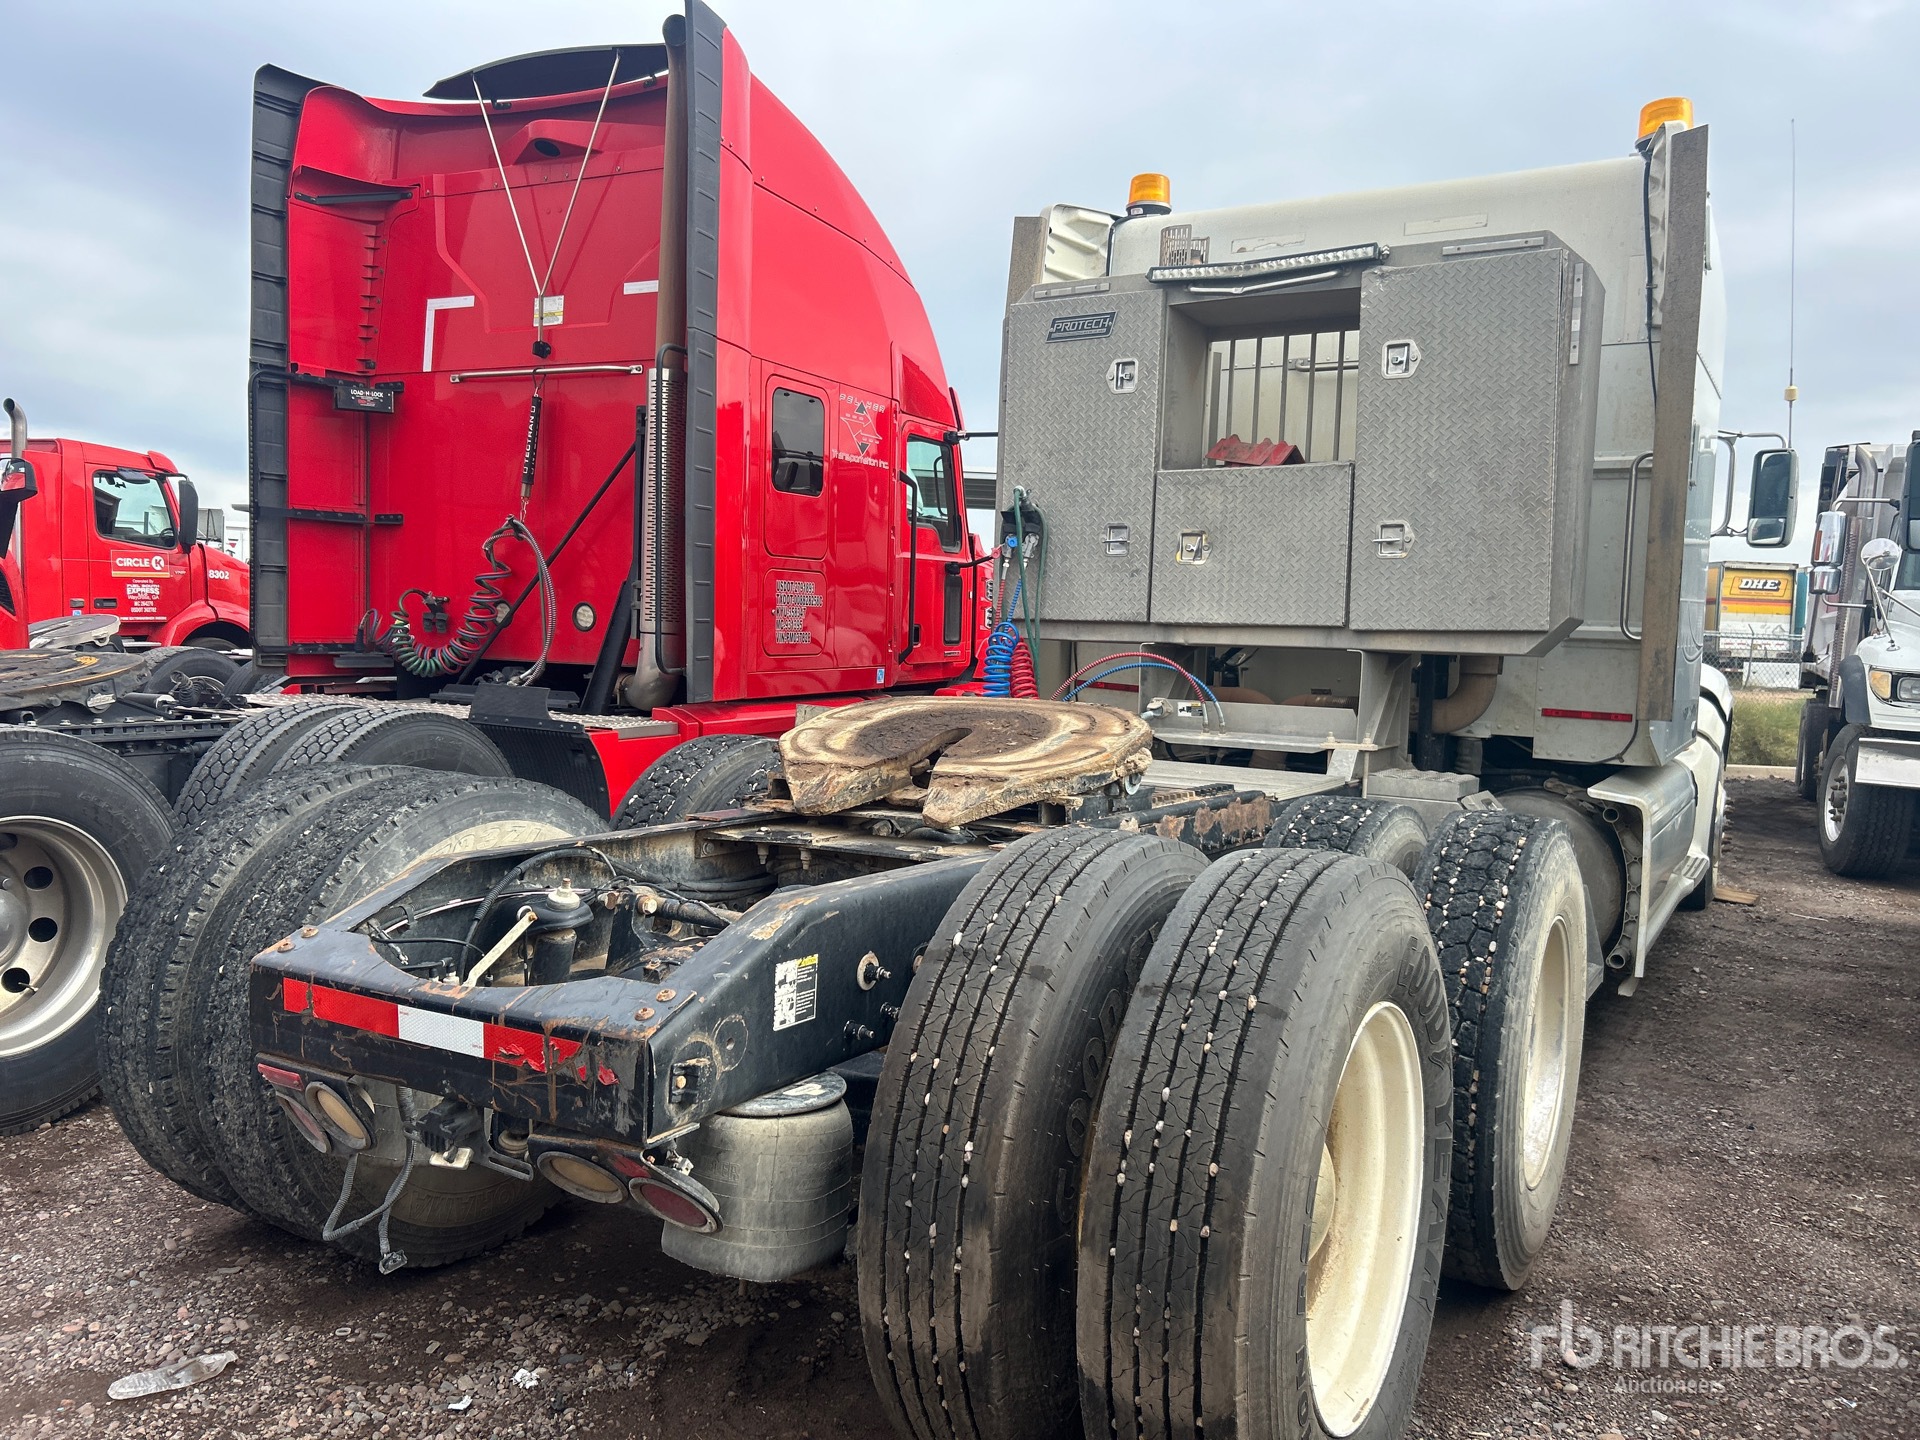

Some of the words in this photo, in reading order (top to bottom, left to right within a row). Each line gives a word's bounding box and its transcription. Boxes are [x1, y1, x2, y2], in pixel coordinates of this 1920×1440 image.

[1053, 318, 1110, 332] PROTECH
[524, 416, 534, 462] TECTRAN
[116, 557, 150, 567] CIRCLE
[152, 556, 164, 570] K
[208, 569, 230, 580] 8302
[126, 587, 160, 595] EXPRESS
[1739, 578, 1781, 591] DHE
